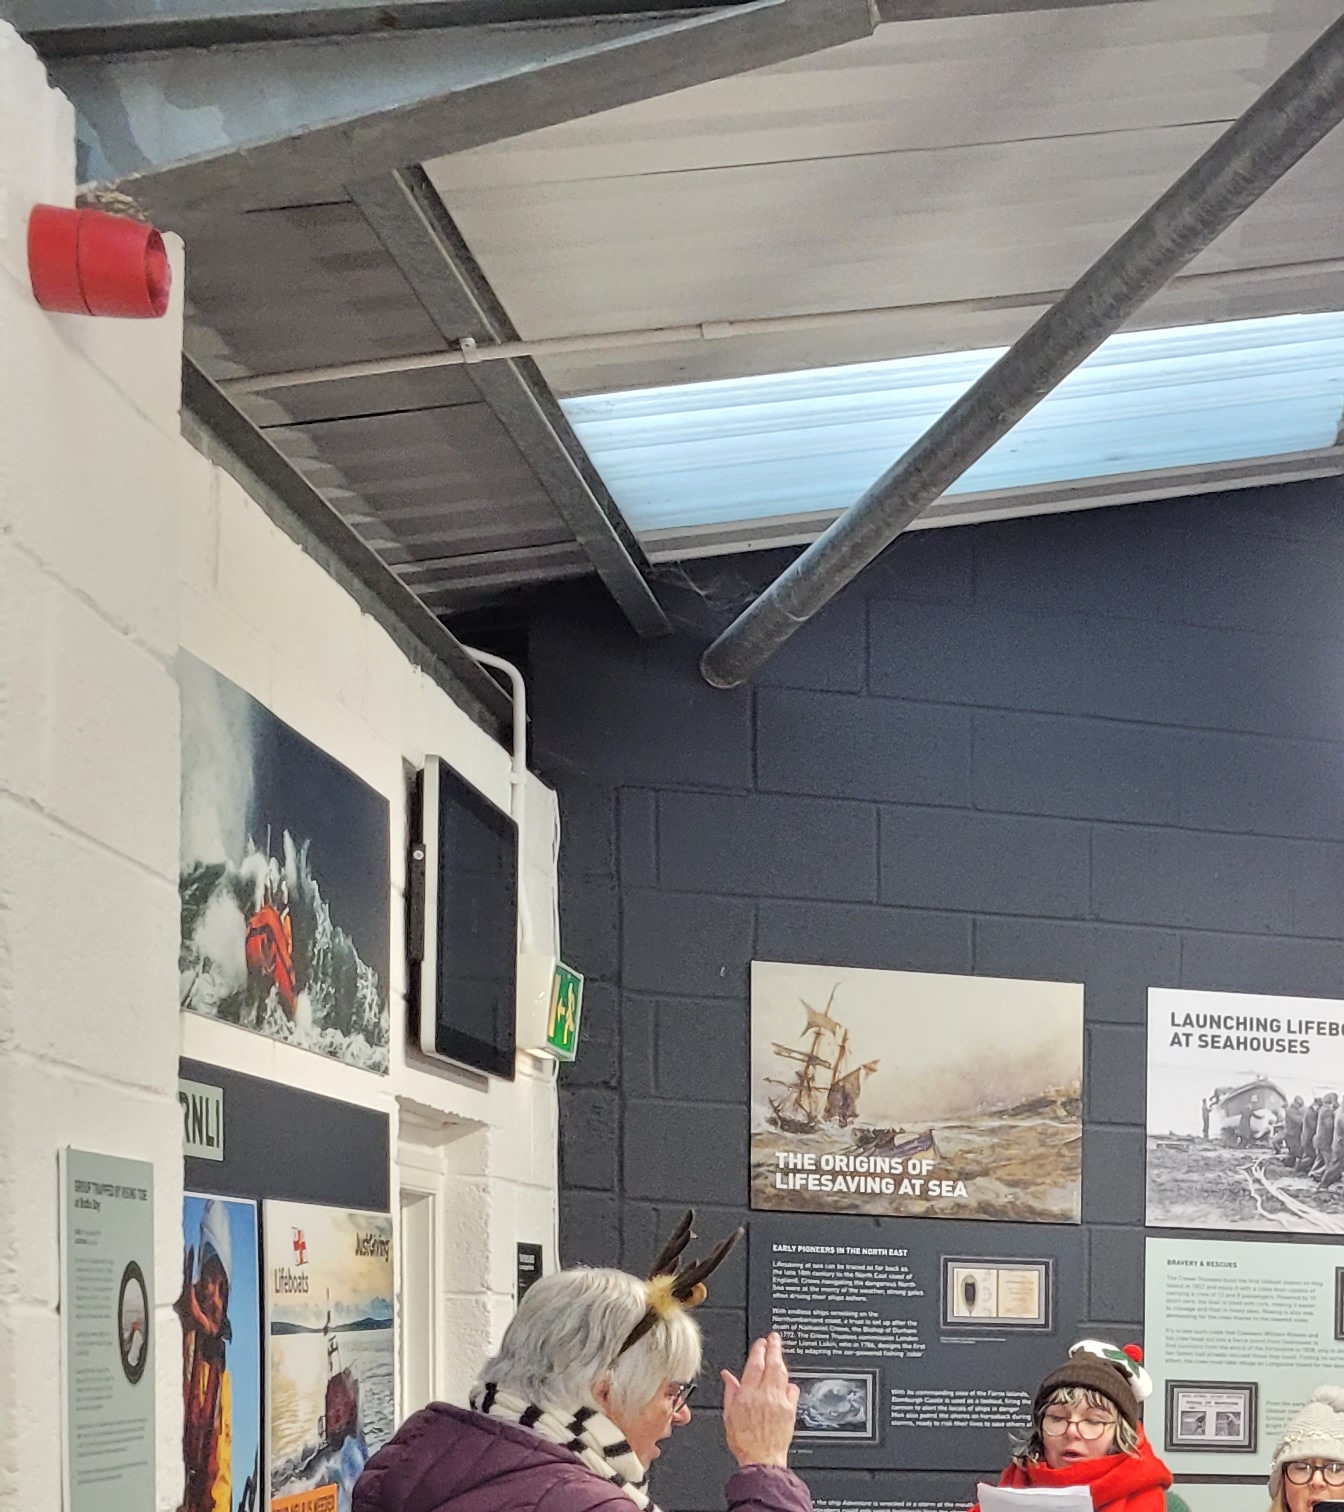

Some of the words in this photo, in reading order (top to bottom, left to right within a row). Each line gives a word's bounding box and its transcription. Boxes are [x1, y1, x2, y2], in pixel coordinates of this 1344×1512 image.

[1170, 1012, 1281, 1032] LAUNCHING
[1170, 1032, 1193, 1047] AT
[1198, 1034, 1311, 1054] SEAHOUSES
[775, 1152, 817, 1171] THE
[820, 1155, 903, 1174] ORIGINS
[907, 1159, 935, 1176] OF
[775, 1173, 895, 1194] LIFESAVING
[898, 1178, 923, 1196] AT
[928, 1180, 969, 1198] SEA
[772, 1244, 796, 1252] EARLY
[797, 1245, 835, 1254] PIONEERS
[836, 1246, 844, 1254] IN
[846, 1246, 861, 1255] THE
[862, 1247, 887, 1255] NORTH
[888, 1248, 908, 1256] EAST
[1167, 1259, 1198, 1267] BRAVERY
[275, 1267, 309, 1293] Lifeboats
